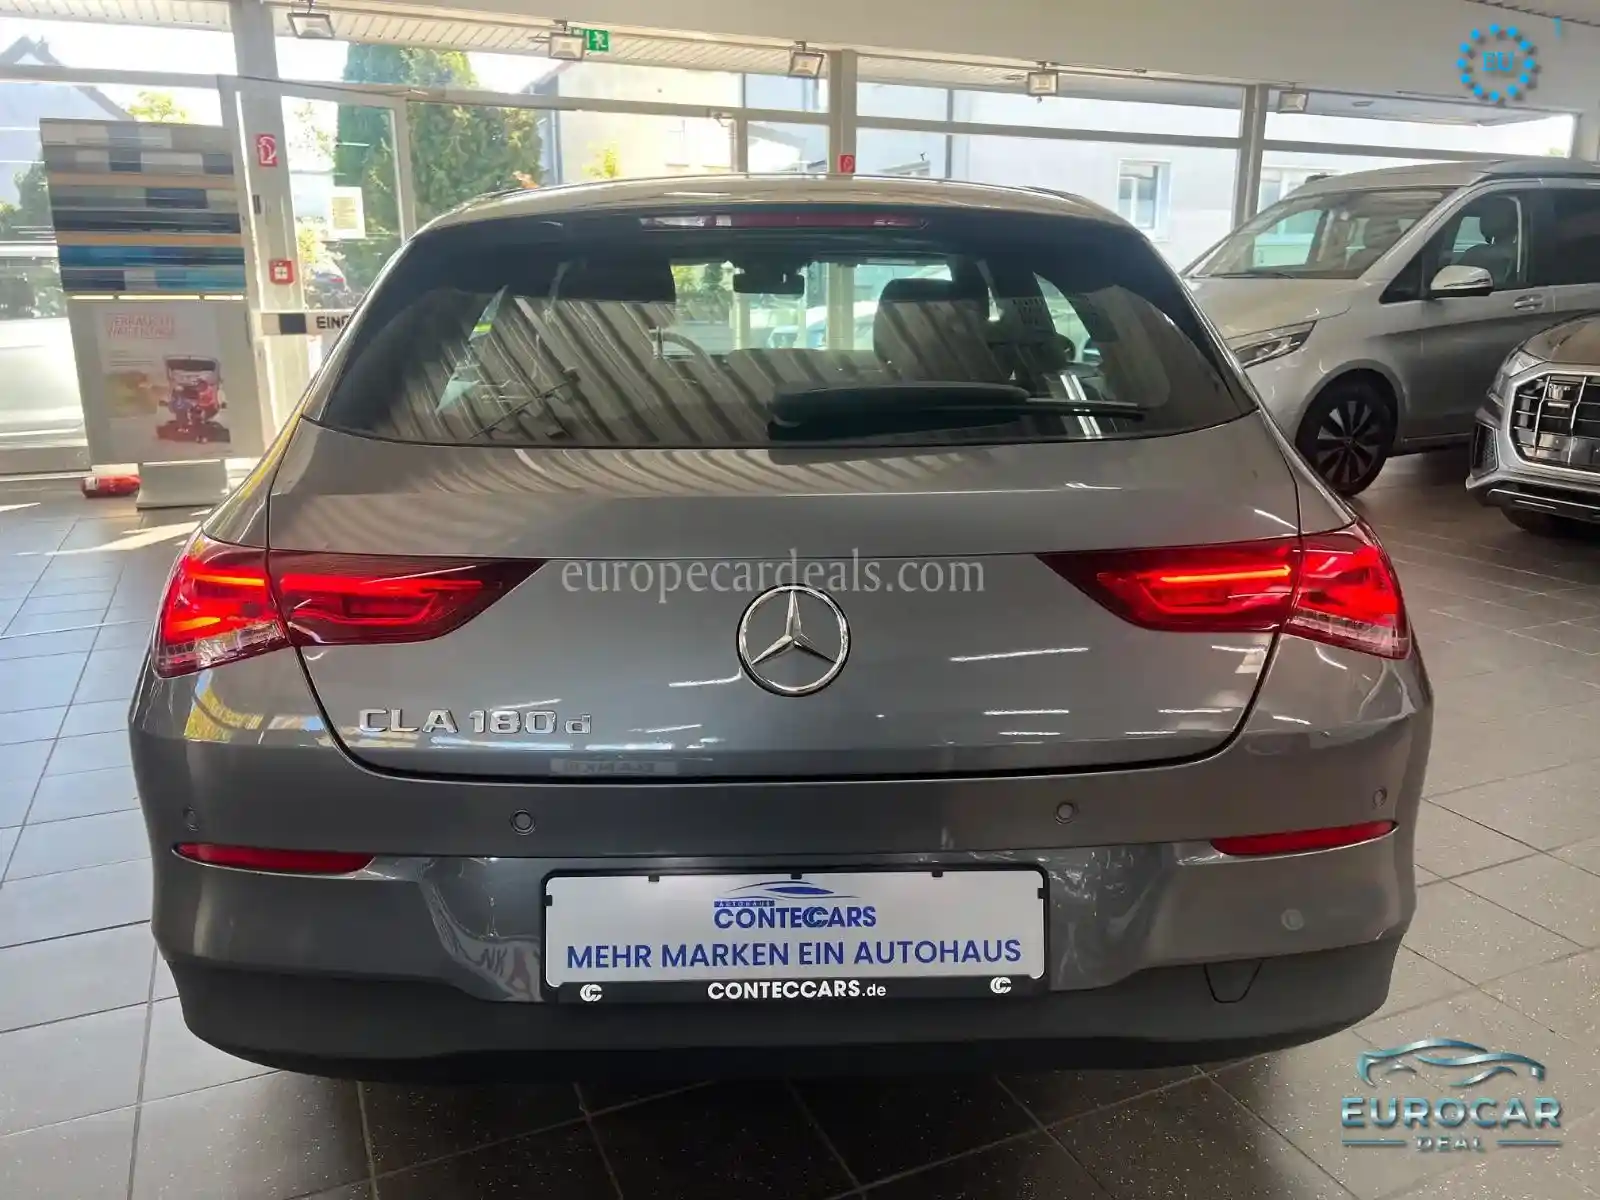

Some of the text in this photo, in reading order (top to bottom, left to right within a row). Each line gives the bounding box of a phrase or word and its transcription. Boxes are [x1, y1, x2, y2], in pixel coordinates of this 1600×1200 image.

[358, 708, 592, 735] CLA 180 d
[567, 939, 1021, 969] MEHR MARKEN EIN AUTOHAUS
[707, 980, 887, 1000] CONTECCARS.de
